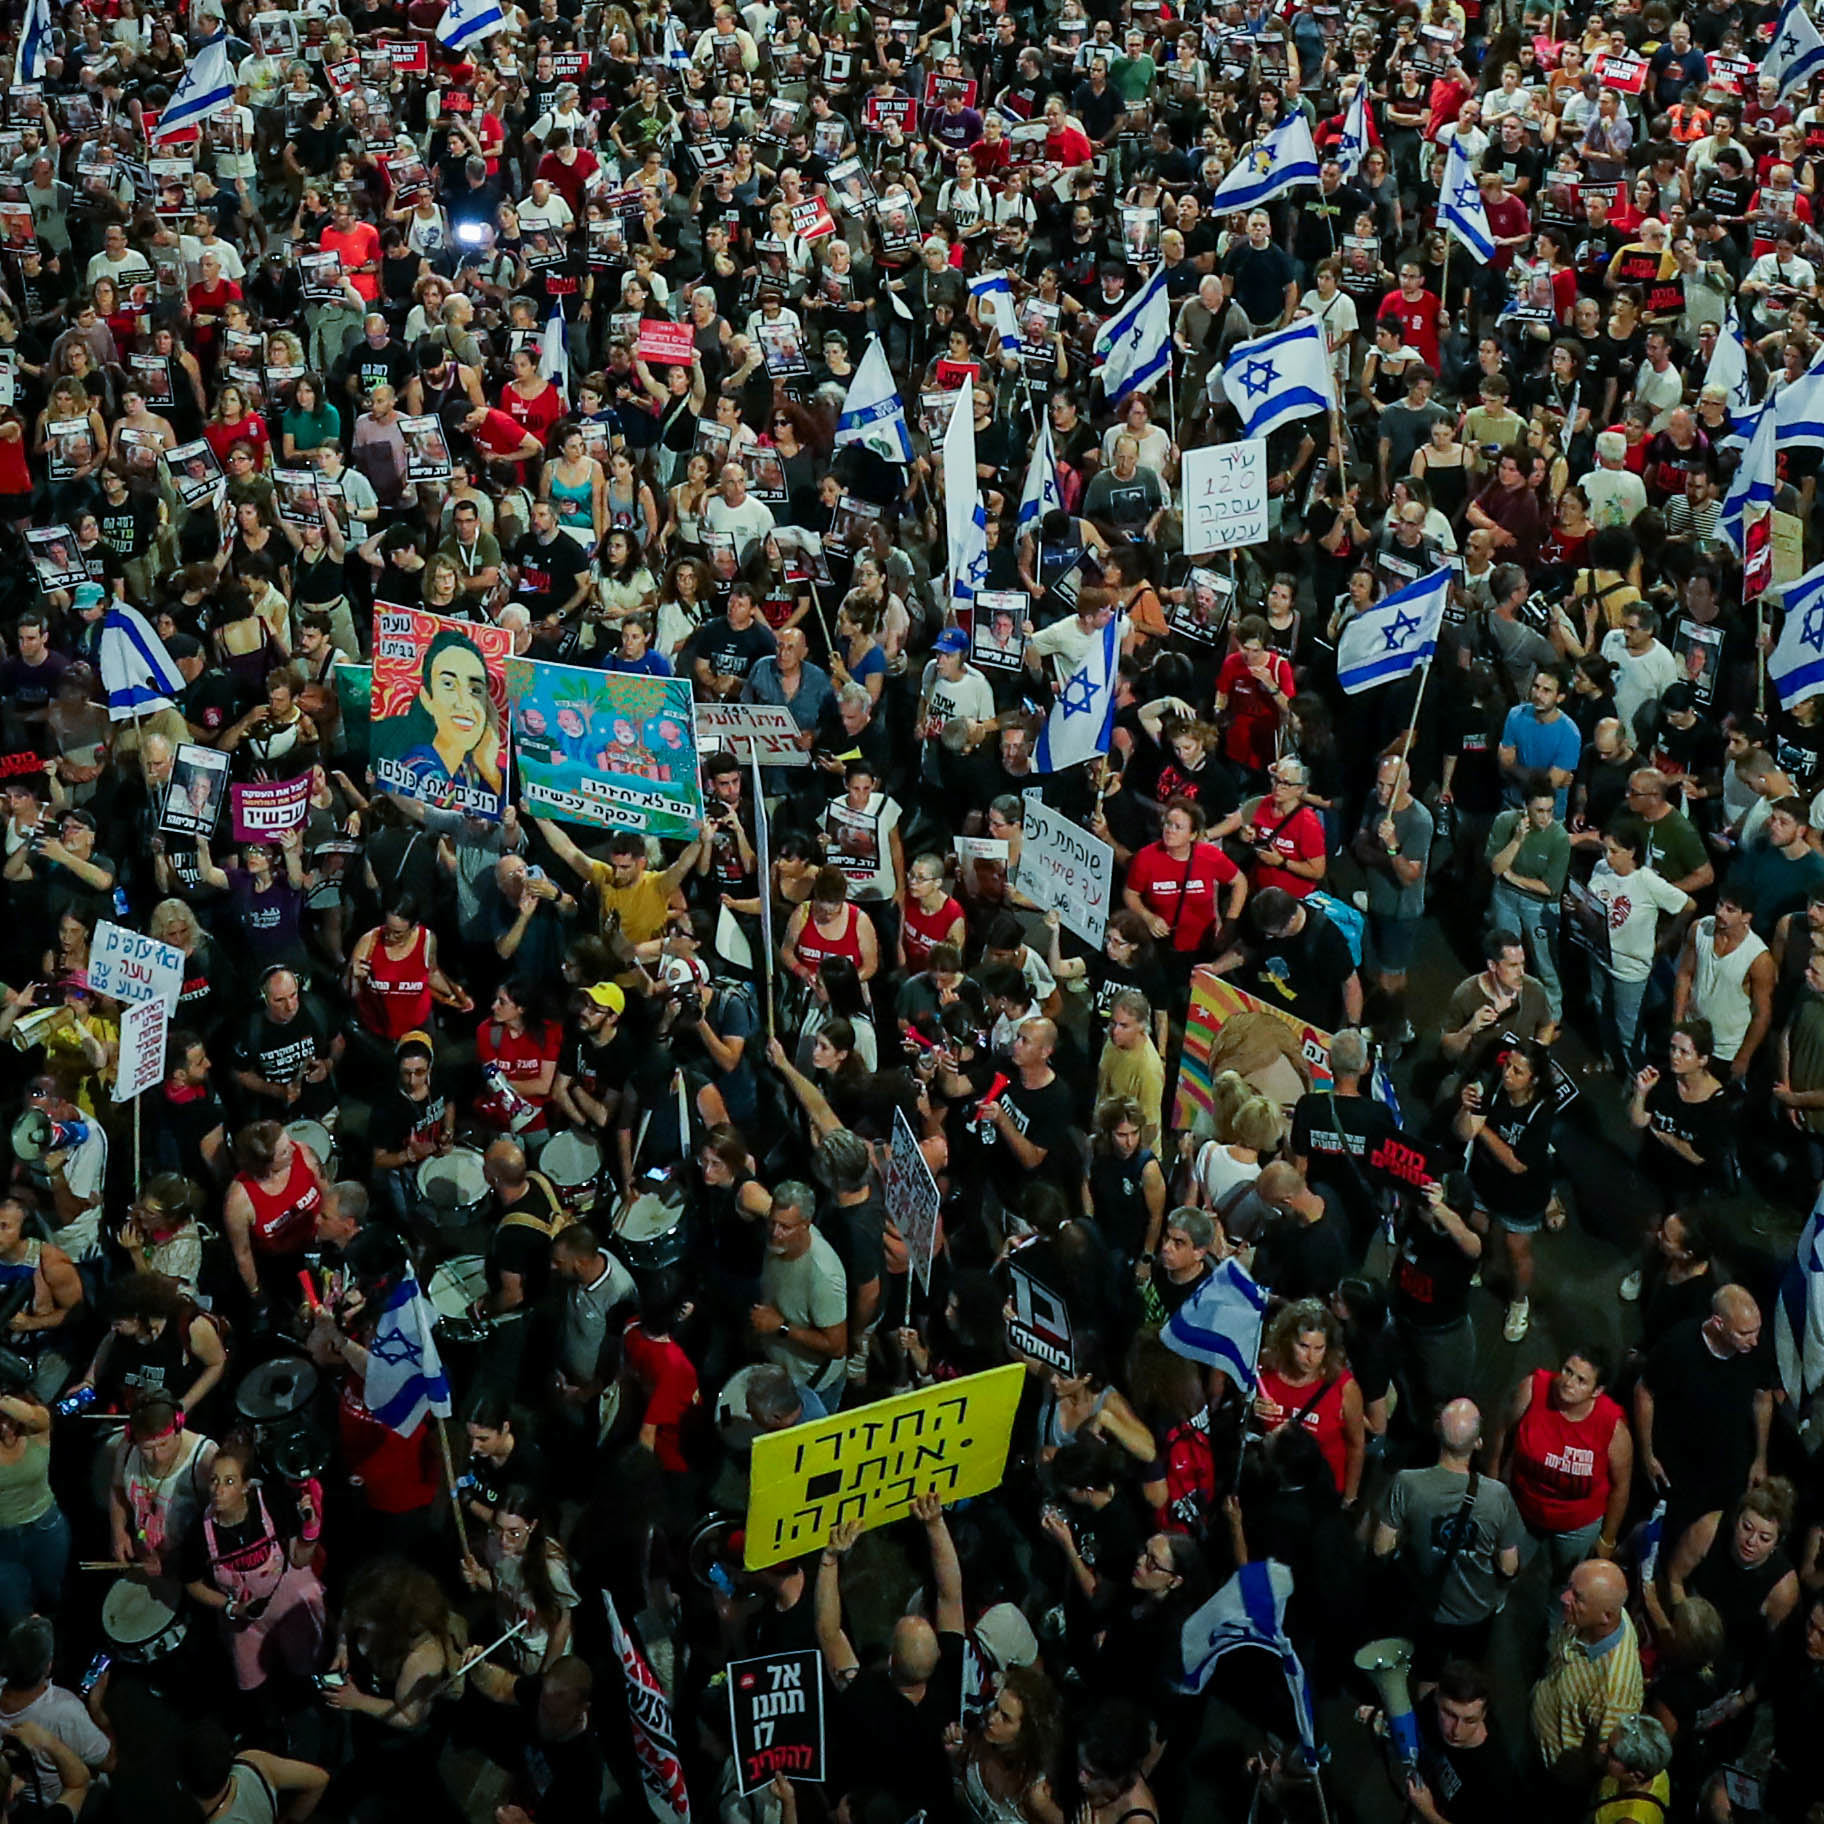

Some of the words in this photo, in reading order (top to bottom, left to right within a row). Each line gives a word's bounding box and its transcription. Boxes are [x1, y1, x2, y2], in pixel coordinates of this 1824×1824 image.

[824, 51, 851, 80] כן
[689, 142, 726, 168] כן
[1206, 471, 1256, 497] 120
[1197, 498, 1260, 523] עסקה
[1205, 522, 1261, 545] עכשיו
[382, 616, 410, 632] נועה
[381, 642, 416, 658] בבית!
[378, 759, 417, 789] כולם!
[242, 790, 275, 798] העסקה
[426, 779, 449, 795] את
[531, 786, 585, 810] עכשיו!
[585, 786, 638, 804] יחזרו.
[455, 787, 498, 813] רוצים
[641, 790, 664, 810] לא
[670, 801, 691, 816] הם
[247, 802, 304, 824] עכשיו
[593, 804, 642, 825] עסקה
[1084, 878, 1102, 907] עד
[95, 961, 112, 977] עד
[118, 959, 152, 984] נועה
[90, 976, 108, 989] 120
[1013, 1268, 1068, 1342] כן
[1013, 1325, 1071, 1372] לעסקה
[793, 1397, 968, 1470] החזירו
[773, 1463, 959, 1552] הביתה!
[766, 1661, 801, 1691] אל
[751, 1688, 805, 1721] תתנו
[753, 1721, 774, 1751] לו
[747, 1744, 813, 1781] להקריב
